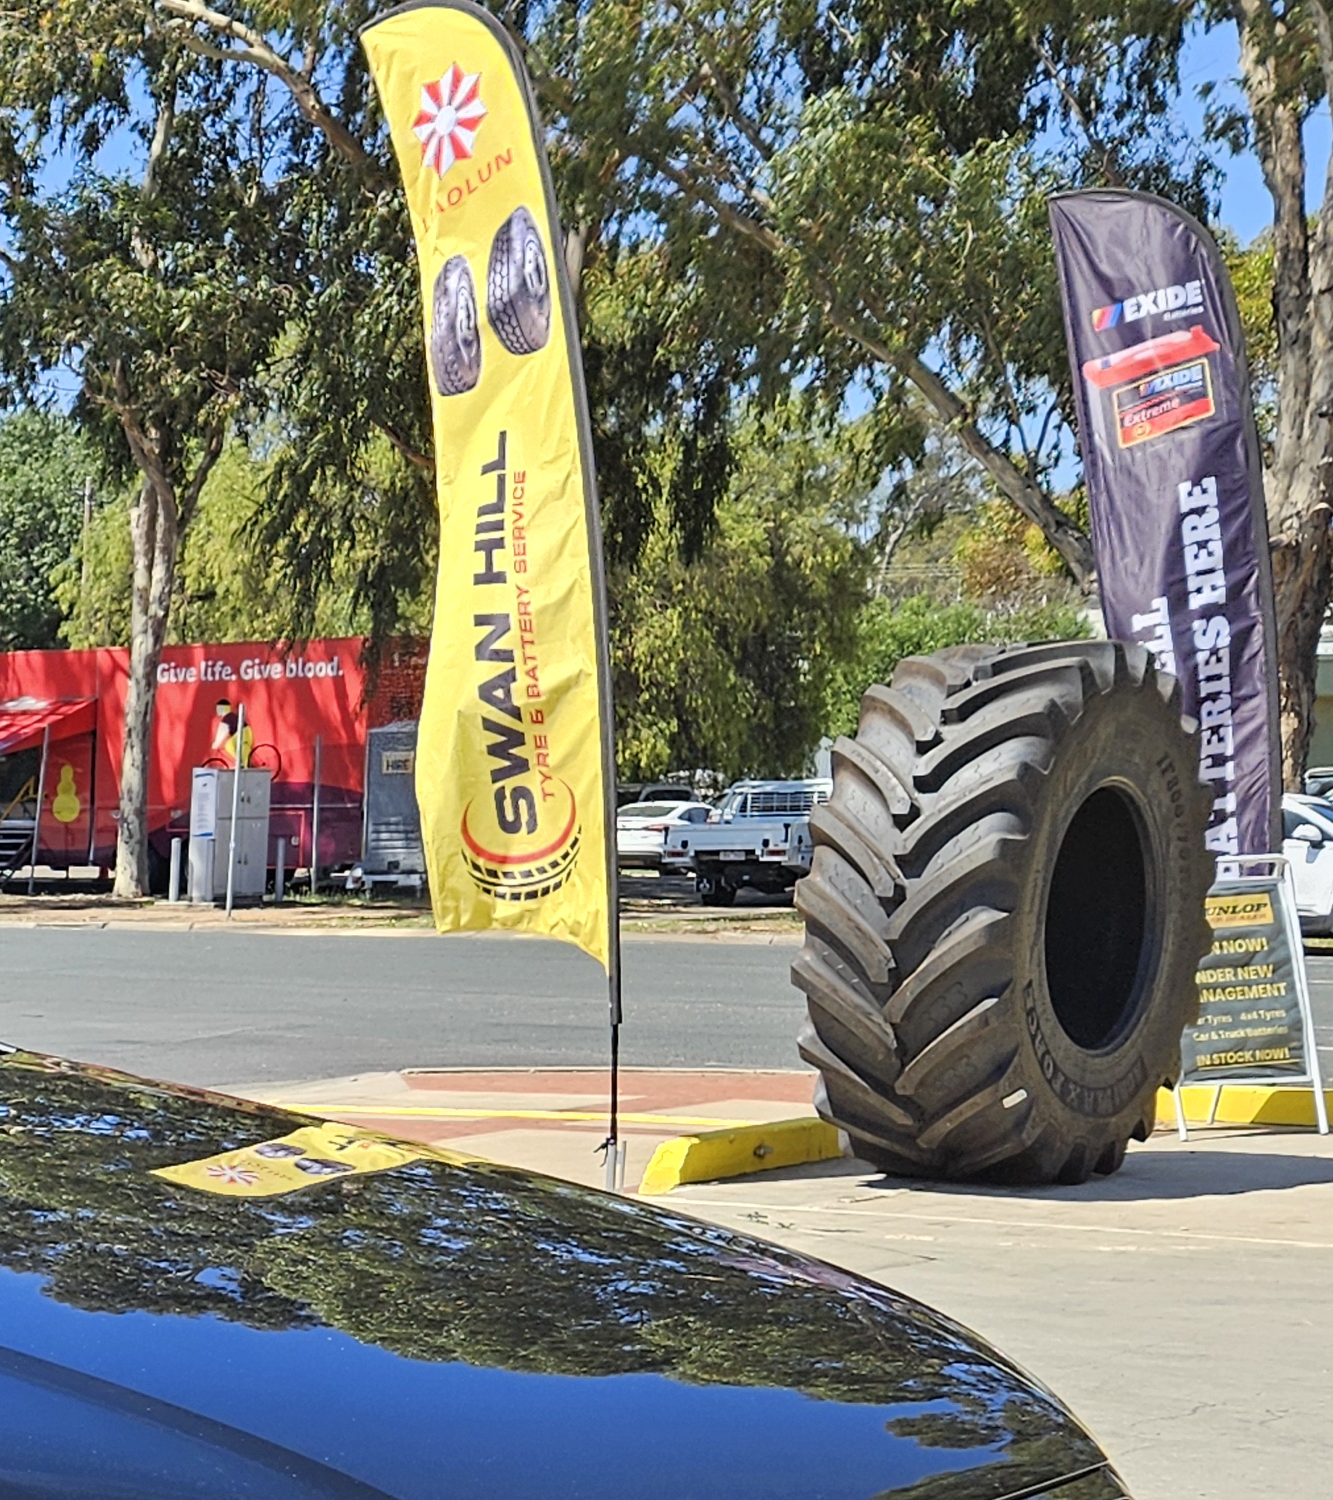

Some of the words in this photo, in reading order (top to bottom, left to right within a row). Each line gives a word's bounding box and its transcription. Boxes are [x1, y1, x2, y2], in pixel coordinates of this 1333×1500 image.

[1123, 280, 1203, 323] EXIDE
[1123, 398, 1181, 427] Extreme
[474, 431, 508, 586] HILL
[512, 470, 527, 574] SERVICE
[1178, 475, 1227, 611] HERE
[516, 583, 542, 699] BATTERY
[157, 662, 197, 683] Give
[200, 660, 237, 681] life.
[240, 658, 283, 680] Give
[286, 656, 344, 678] blood.
[474, 613, 538, 836] SWAN
[534, 735, 555, 801] TYRE
[1206, 903, 1268, 917] UNLOP
[1221, 937, 1269, 955] NOW!
[1237, 964, 1273, 981] NEW
[1212, 1050, 1254, 1065] STOCK
[1255, 1047, 1291, 1061] NOW!
